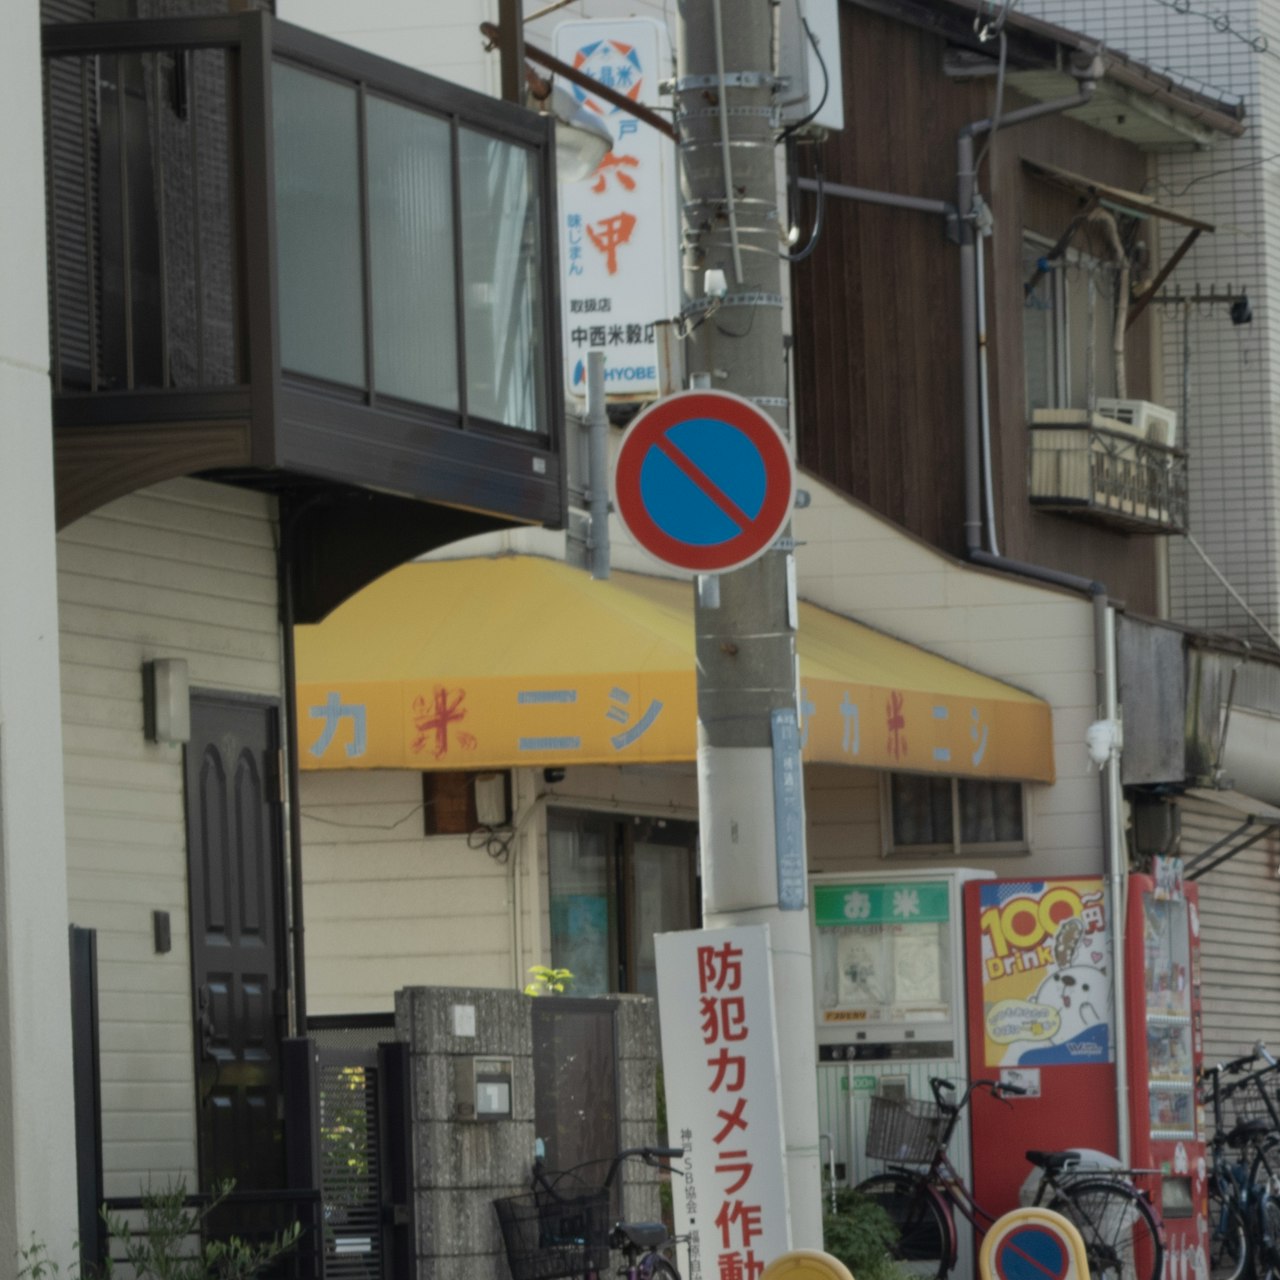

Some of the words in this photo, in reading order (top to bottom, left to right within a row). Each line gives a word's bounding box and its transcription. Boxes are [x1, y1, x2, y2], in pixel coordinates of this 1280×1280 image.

[567, 213, 584, 276] 味じまん
[570, 298, 612, 313] 取扱店
[985, 944, 1055, 981] Drink
